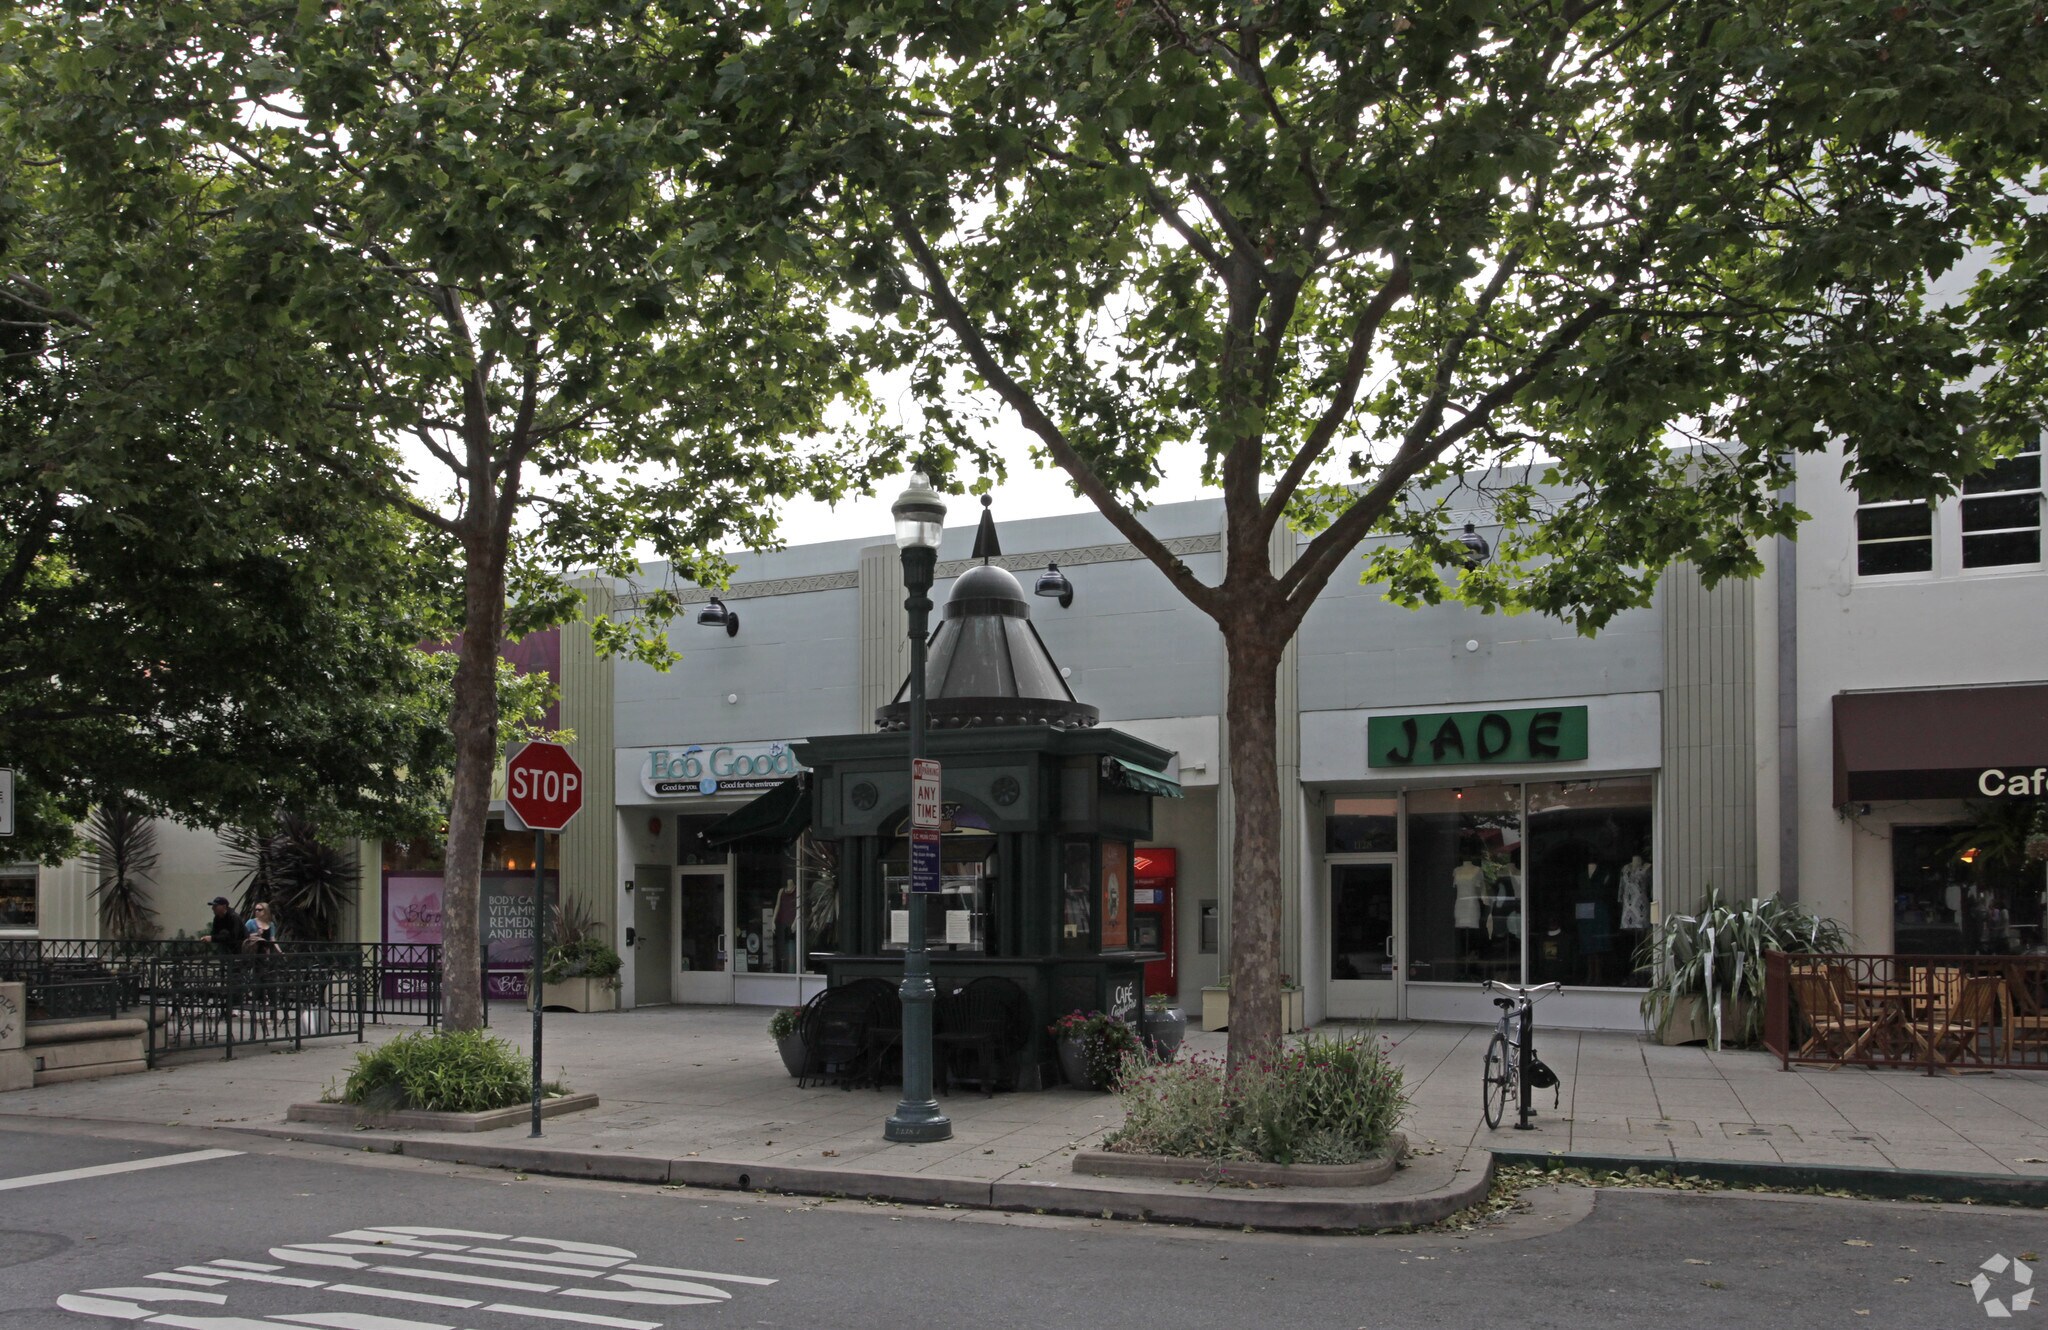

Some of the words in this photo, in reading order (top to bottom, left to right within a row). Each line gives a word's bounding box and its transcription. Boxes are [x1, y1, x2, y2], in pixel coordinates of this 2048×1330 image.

[1386, 711, 1562, 762] JADE
[649, 750, 702, 779] Eco
[709, 745, 798, 777] Good
[512, 767, 578, 803] STOP
[661, 783, 677, 791] Good
[720, 780, 737, 789] Good
[1978, 767, 2048, 797] Caf
[917, 786, 936, 801] ANY
[916, 803, 937, 819] TIME
[489, 896, 515, 905] BODY
[404, 904, 441, 923] Bloo
[490, 917, 546, 928] REMEDI
[488, 929, 513, 939] AND
[515, 929, 546, 939] HER
